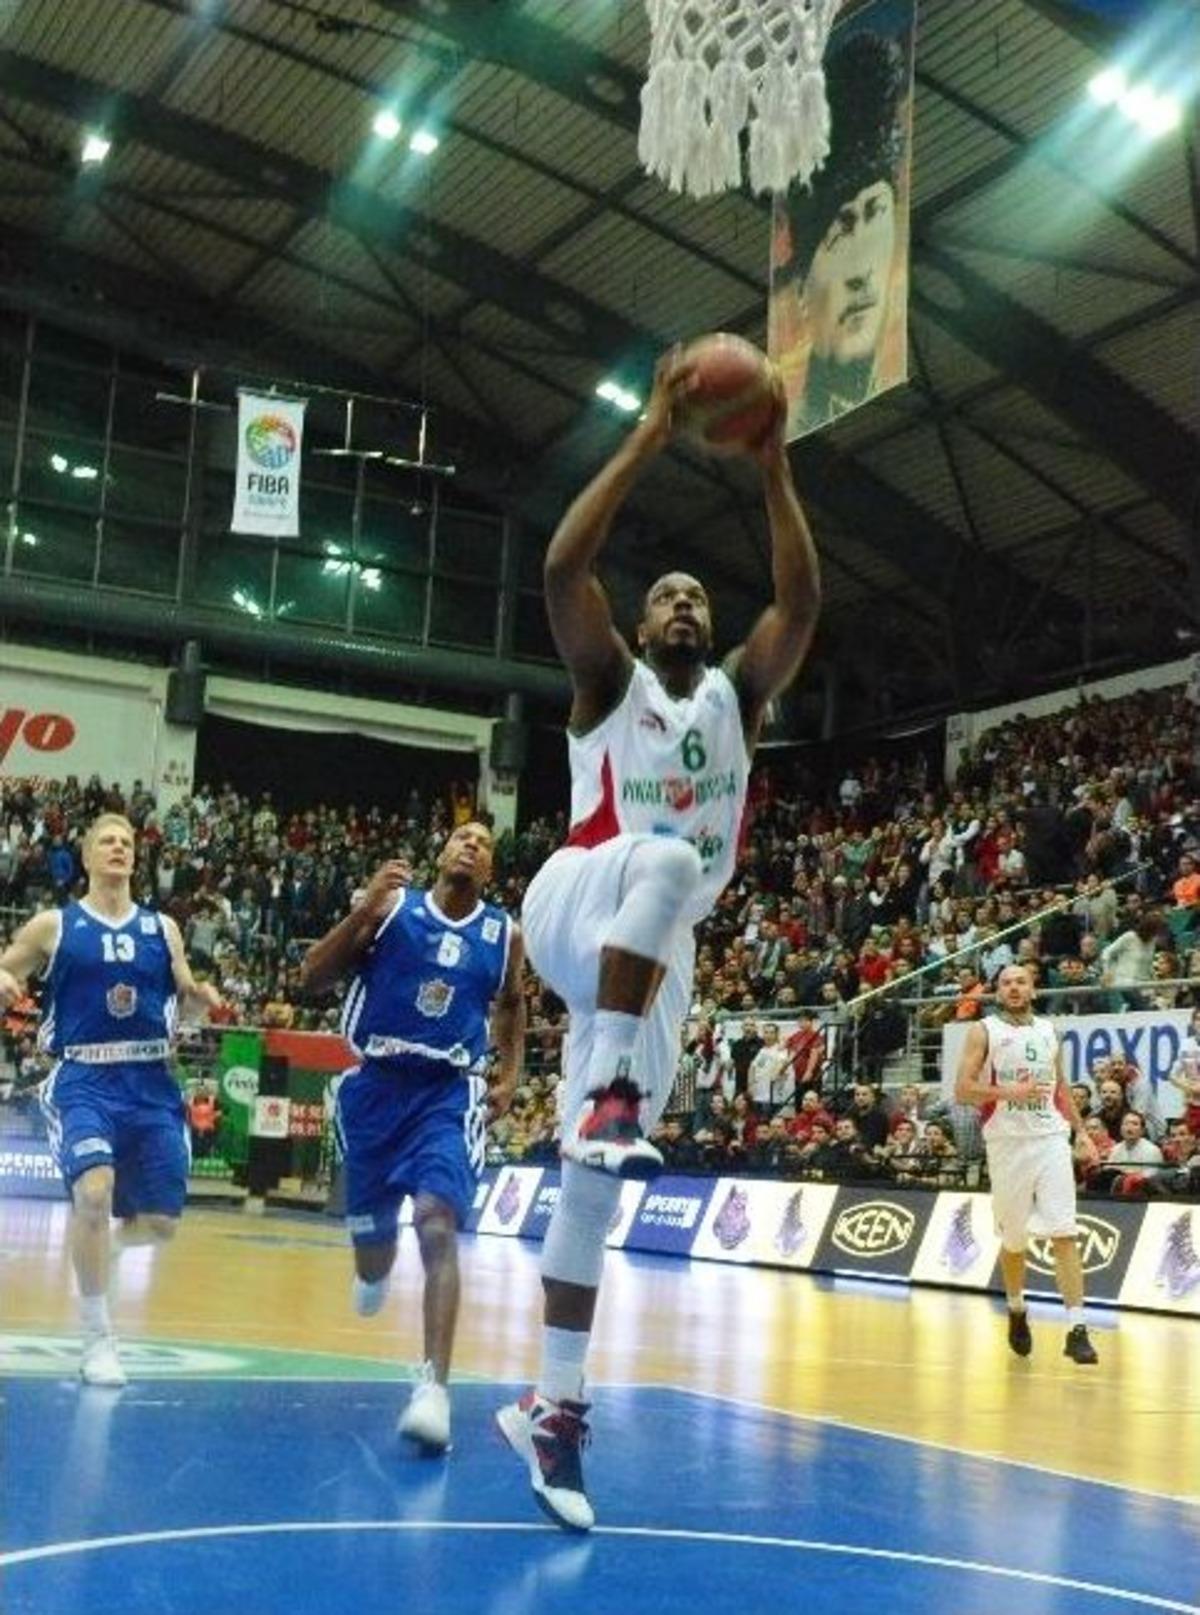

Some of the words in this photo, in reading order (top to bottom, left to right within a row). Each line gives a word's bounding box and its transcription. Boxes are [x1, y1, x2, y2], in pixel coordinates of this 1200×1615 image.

[247, 472, 289, 495] FIBA
[682, 728, 706, 771] 6
[102, 933, 136, 962] 13
[1025, 1042, 1037, 1062] 5
[834, 1207, 913, 1249] KEEN
